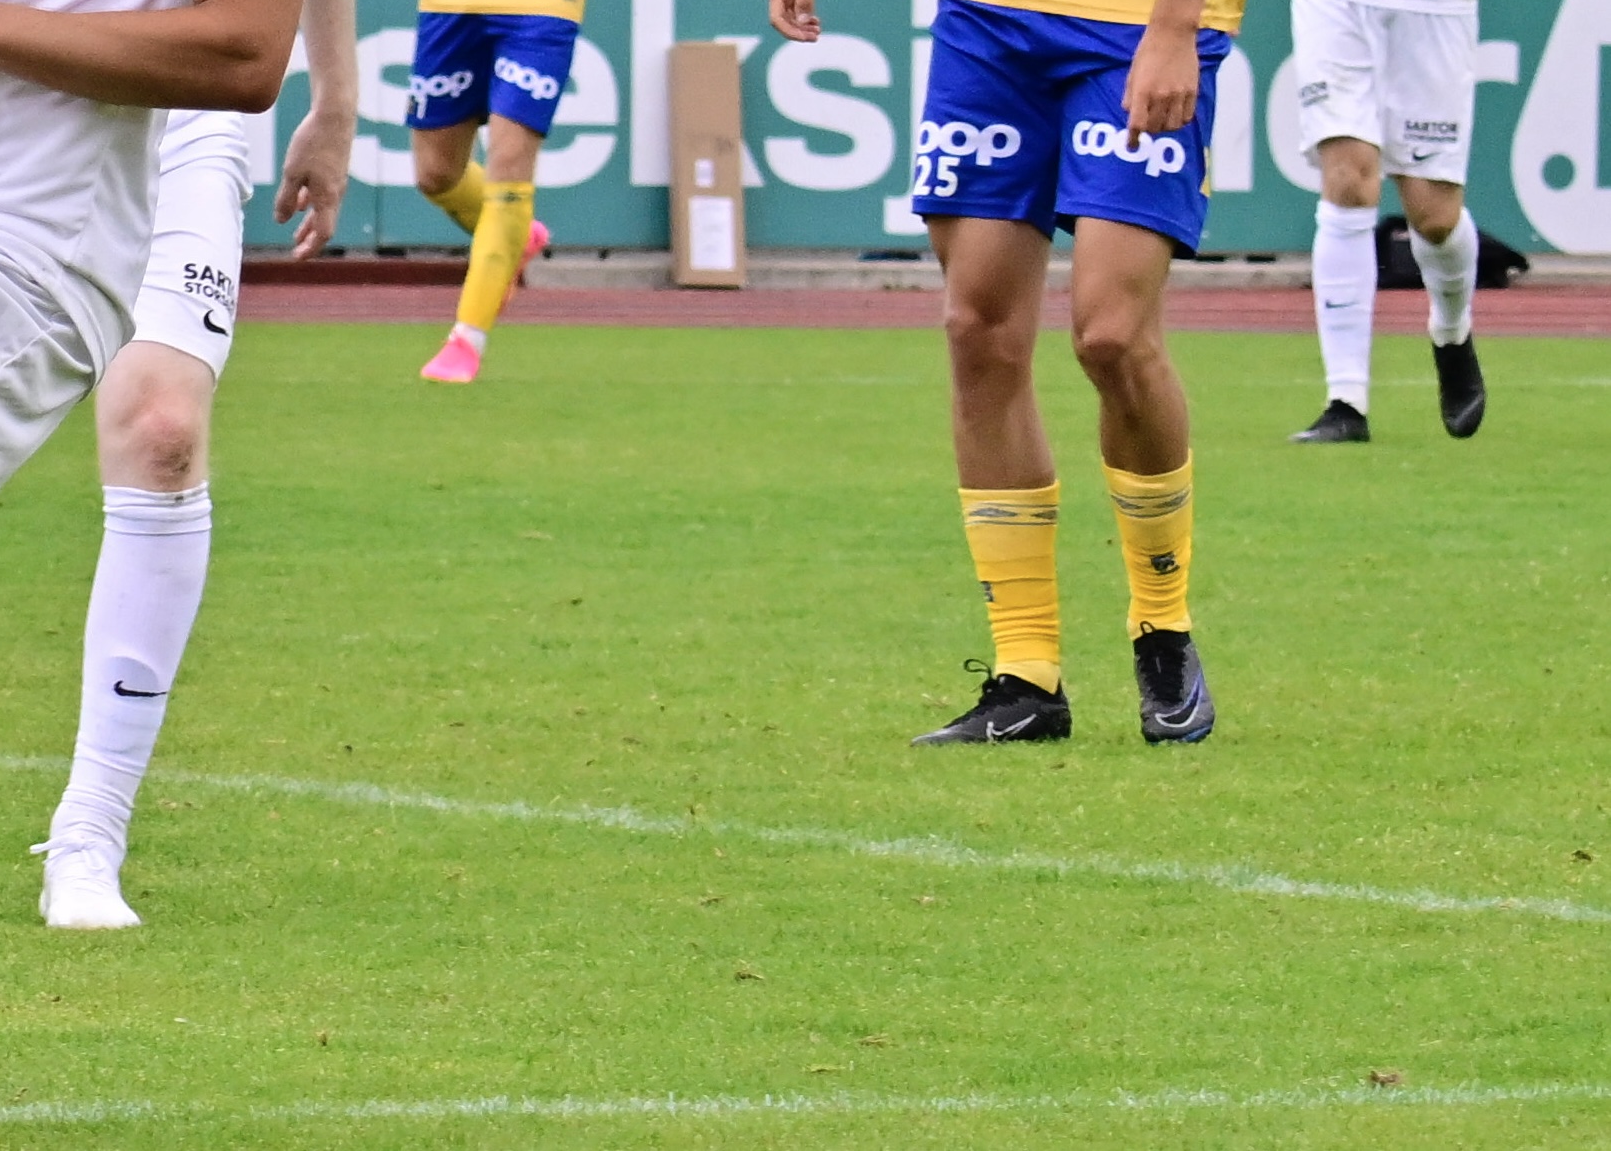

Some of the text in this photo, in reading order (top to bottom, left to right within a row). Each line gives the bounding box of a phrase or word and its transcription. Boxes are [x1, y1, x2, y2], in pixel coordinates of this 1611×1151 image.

[494, 56, 560, 100] coop
[1072, 120, 1186, 178] coop
[912, 155, 961, 197] 25
